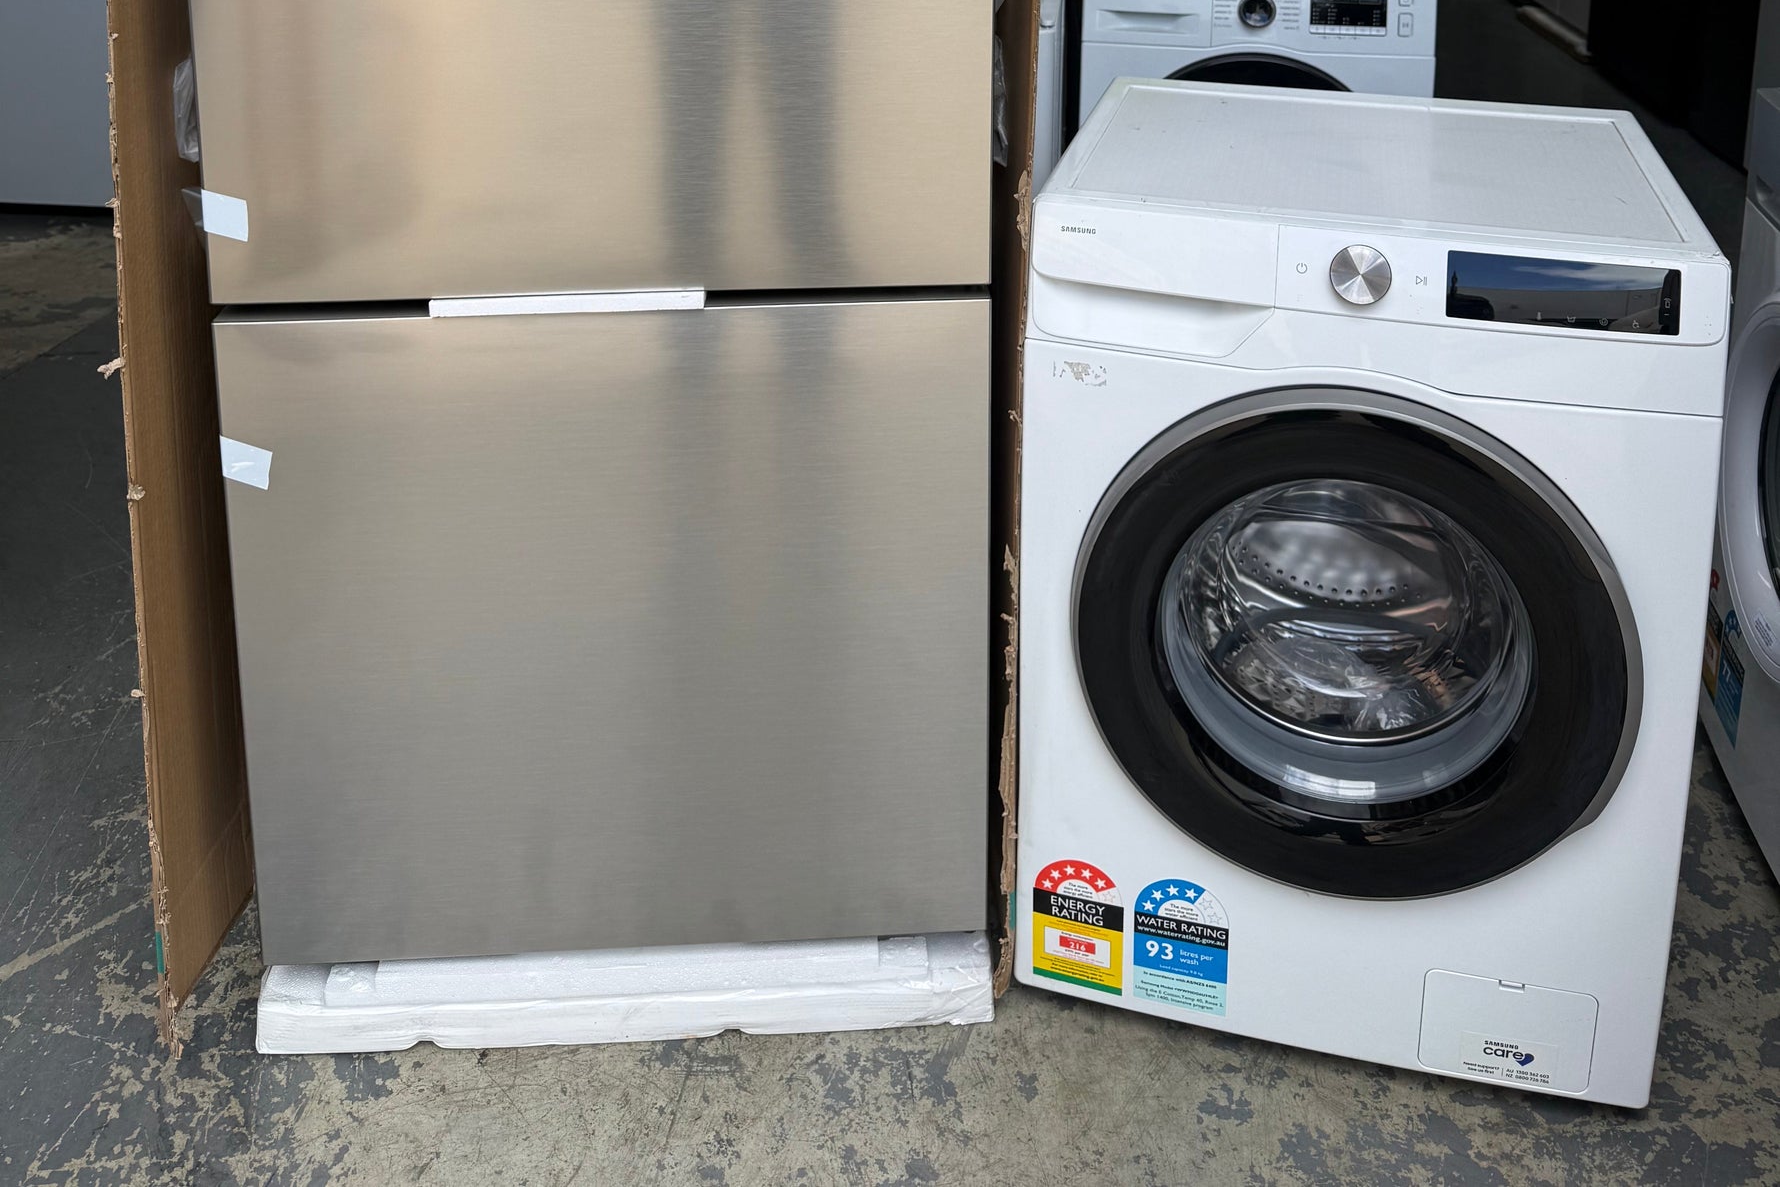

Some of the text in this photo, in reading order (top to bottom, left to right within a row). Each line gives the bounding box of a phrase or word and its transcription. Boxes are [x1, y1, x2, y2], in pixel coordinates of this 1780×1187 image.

[1060, 225, 1097, 235] SAMSUNG
[1050, 895, 1106, 916] ENERGY
[1052, 906, 1104, 926] RATING
[1136, 914, 1226, 940] WATER RATING
[1137, 925, 1226, 947] www.waterrating.gov.au
[1069, 942, 1086, 952] 216
[1146, 940, 1174, 960] 93
[1180, 949, 1214, 962] litres per
[1180, 958, 1199, 966] wash
[1484, 1040, 1519, 1050] SAMSUNG
[1483, 1046, 1524, 1060] care
